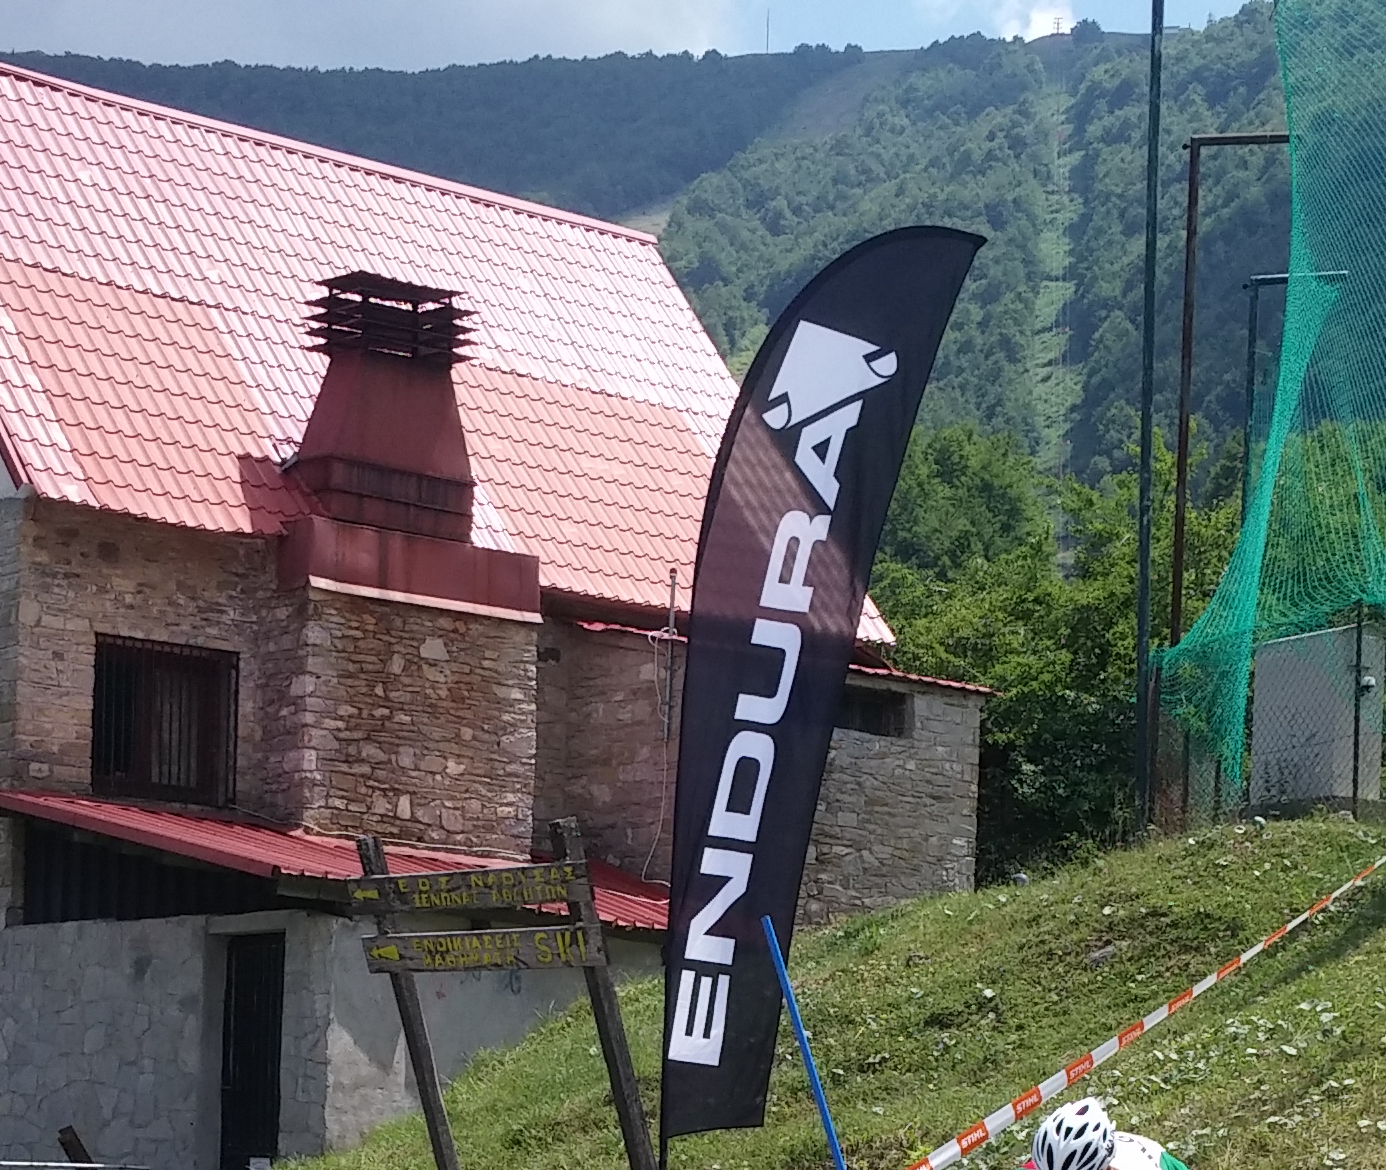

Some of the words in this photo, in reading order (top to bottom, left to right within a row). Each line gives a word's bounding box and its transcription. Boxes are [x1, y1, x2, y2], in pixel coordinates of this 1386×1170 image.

[667, 399, 863, 1067] ENDURA
[534, 930, 587, 964] SKI
[961, 1127, 987, 1149] STIHL
[1016, 1093, 1039, 1114] STIHL
